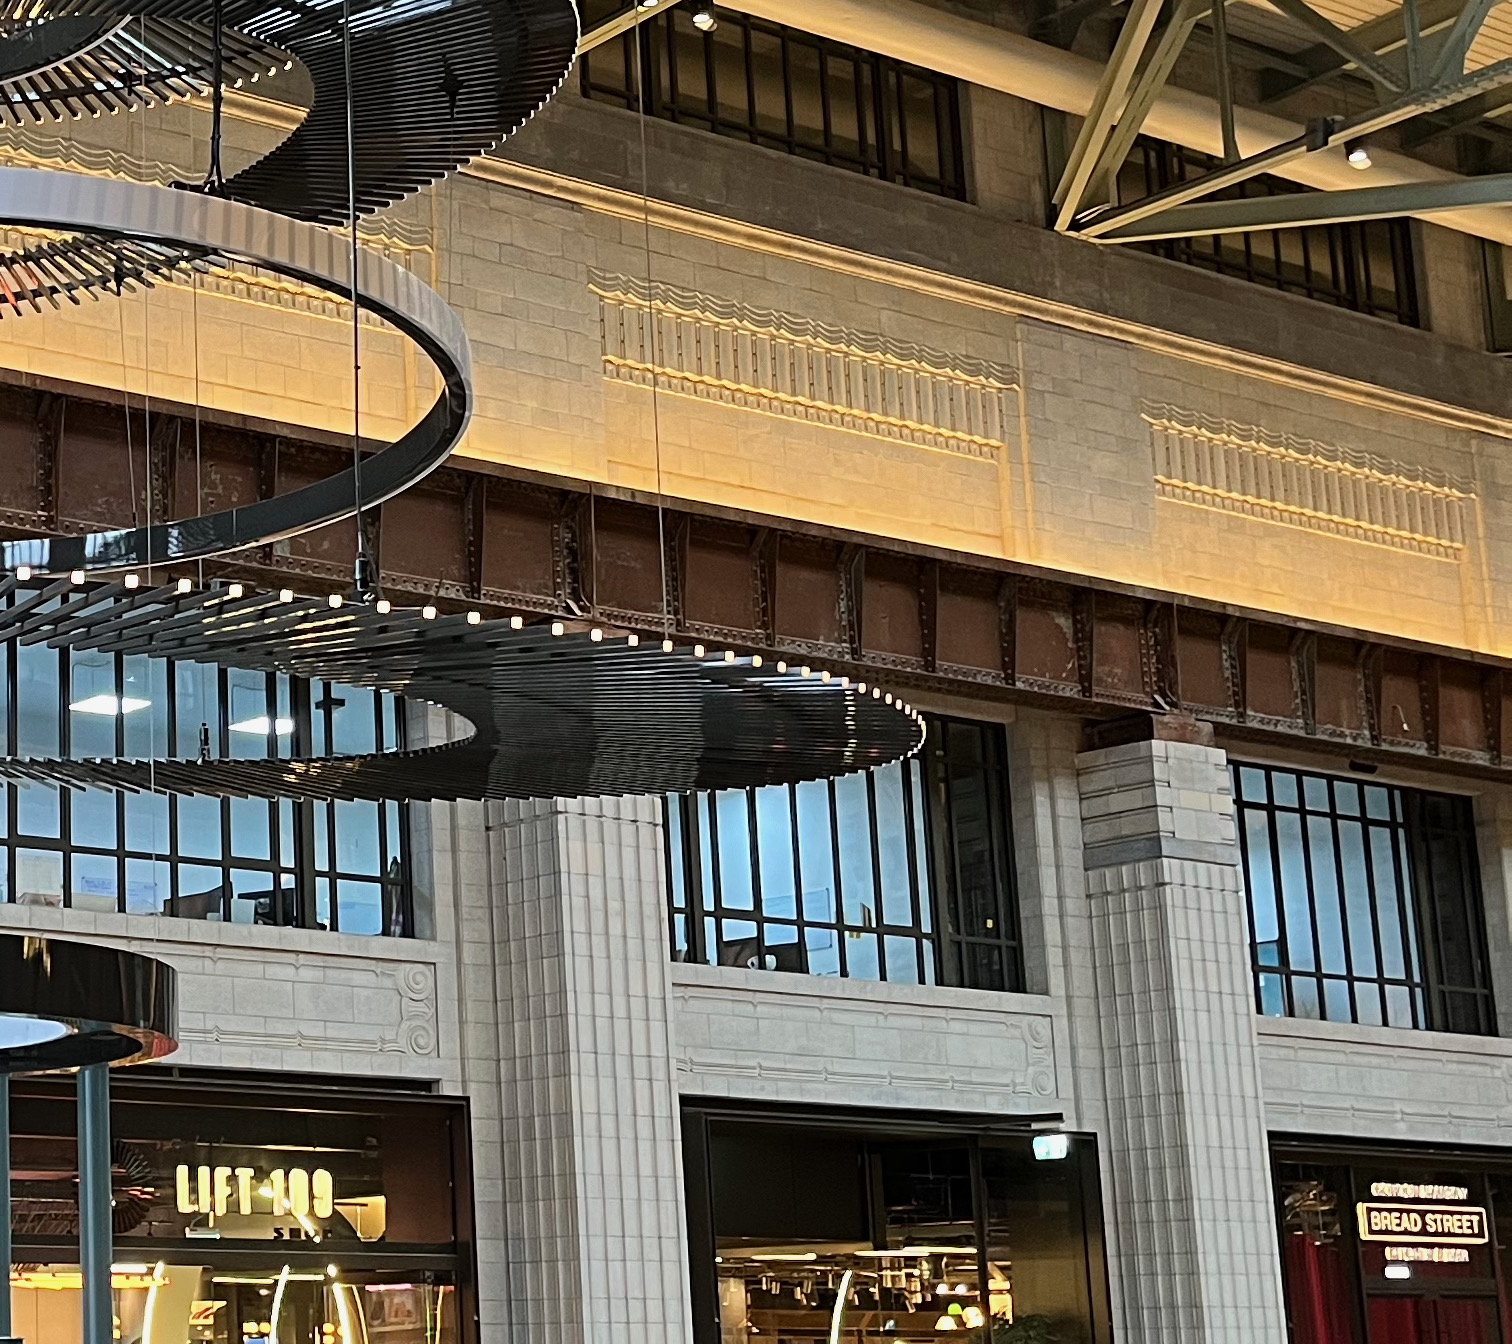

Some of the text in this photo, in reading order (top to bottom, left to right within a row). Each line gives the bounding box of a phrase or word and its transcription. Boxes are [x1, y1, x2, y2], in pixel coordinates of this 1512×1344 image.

[175, 1164, 334, 1219] LIFT 109
[1370, 1211, 1480, 1234] BREAD STREET
